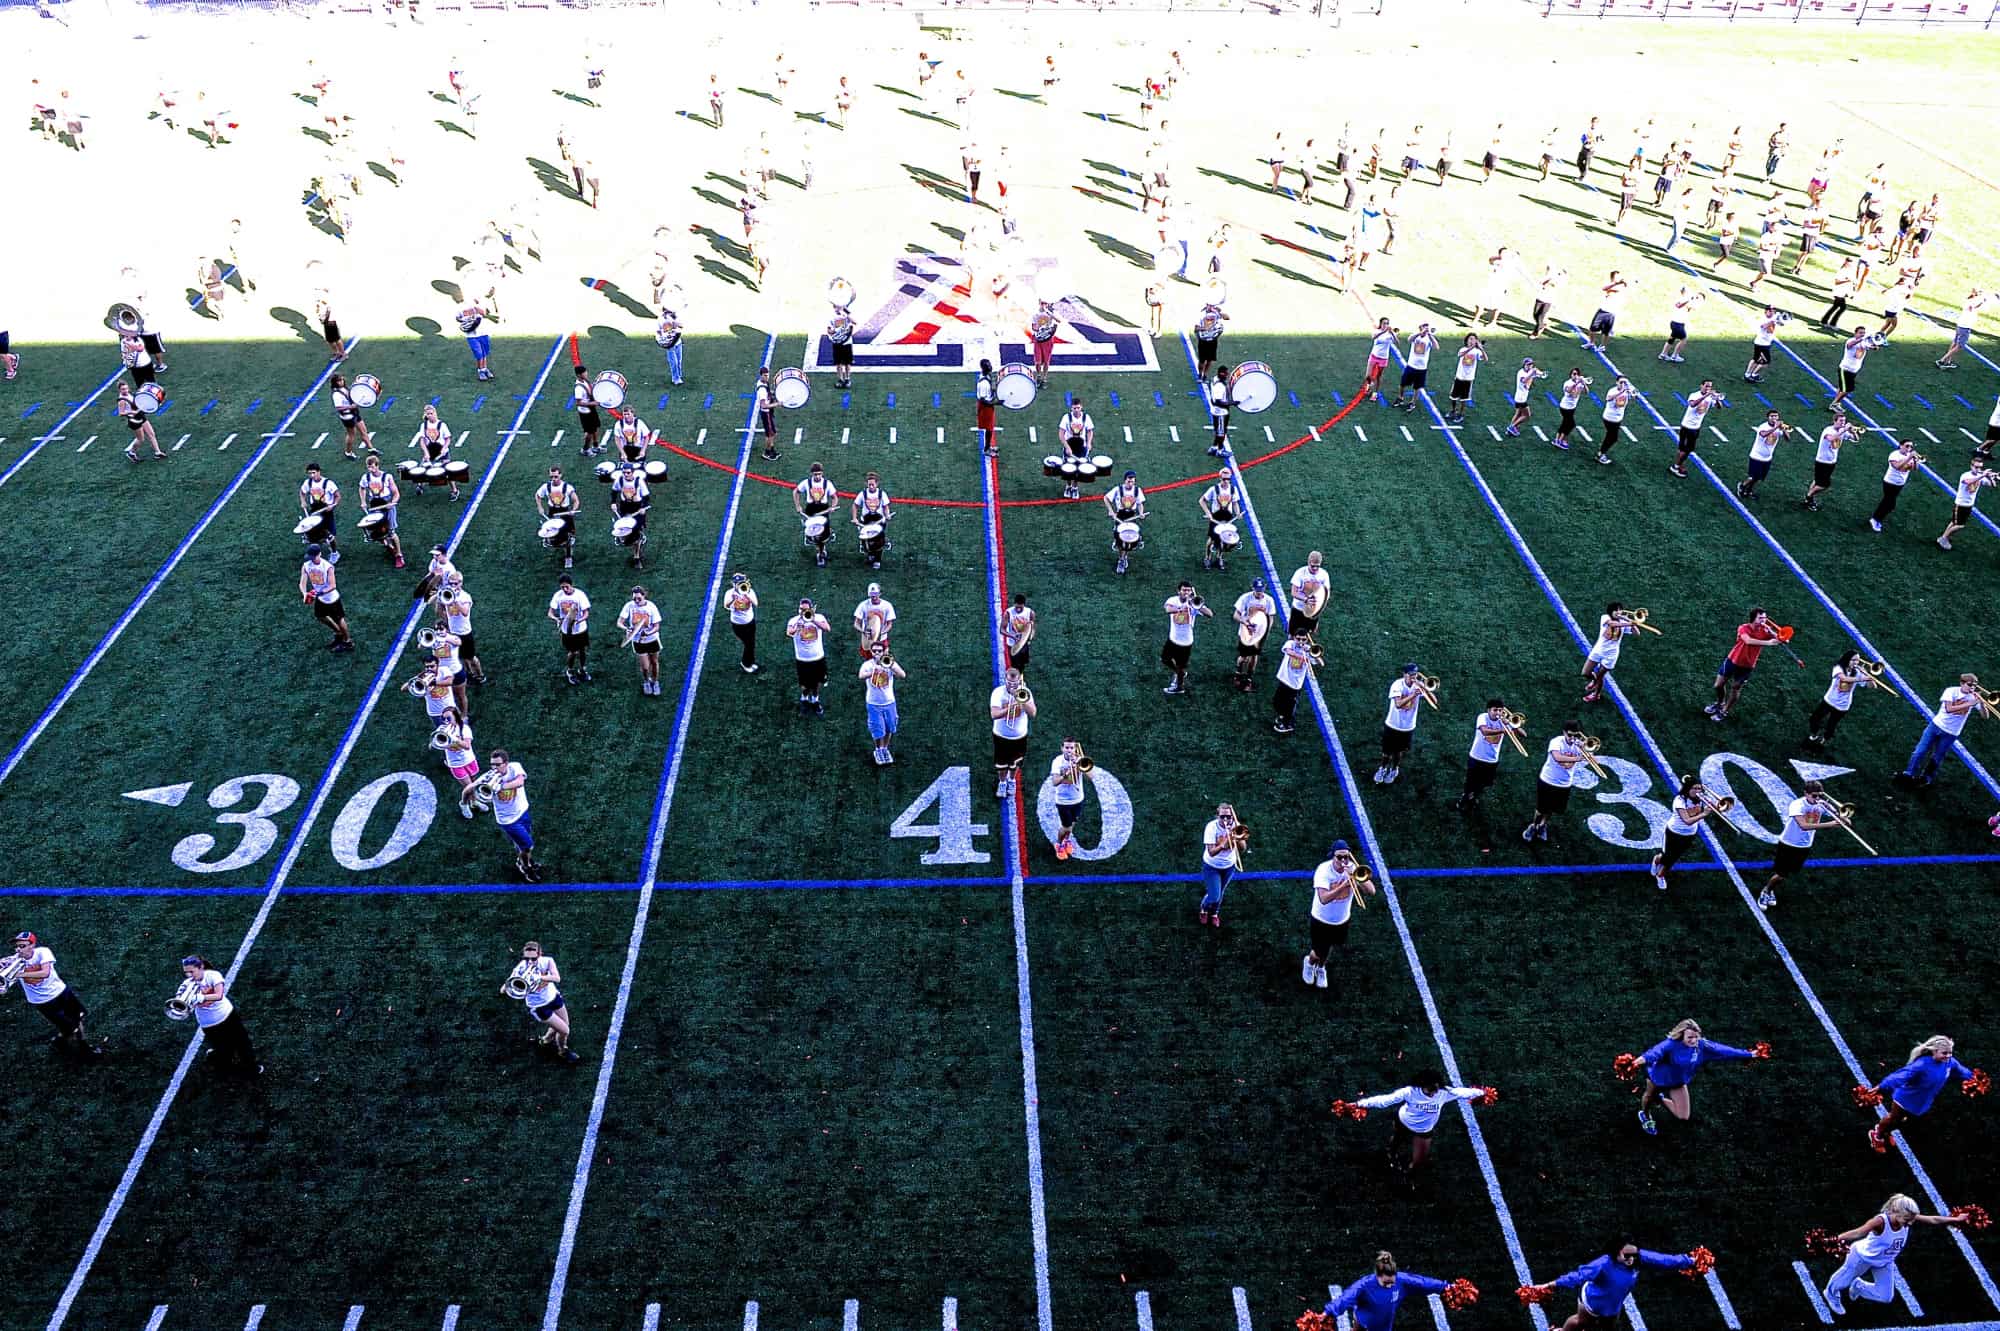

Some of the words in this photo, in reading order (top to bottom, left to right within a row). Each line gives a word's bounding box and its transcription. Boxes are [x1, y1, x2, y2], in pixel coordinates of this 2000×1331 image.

[171, 773, 437, 873] 30
[890, 766, 1134, 865] 40
[1571, 752, 1799, 850] 30
